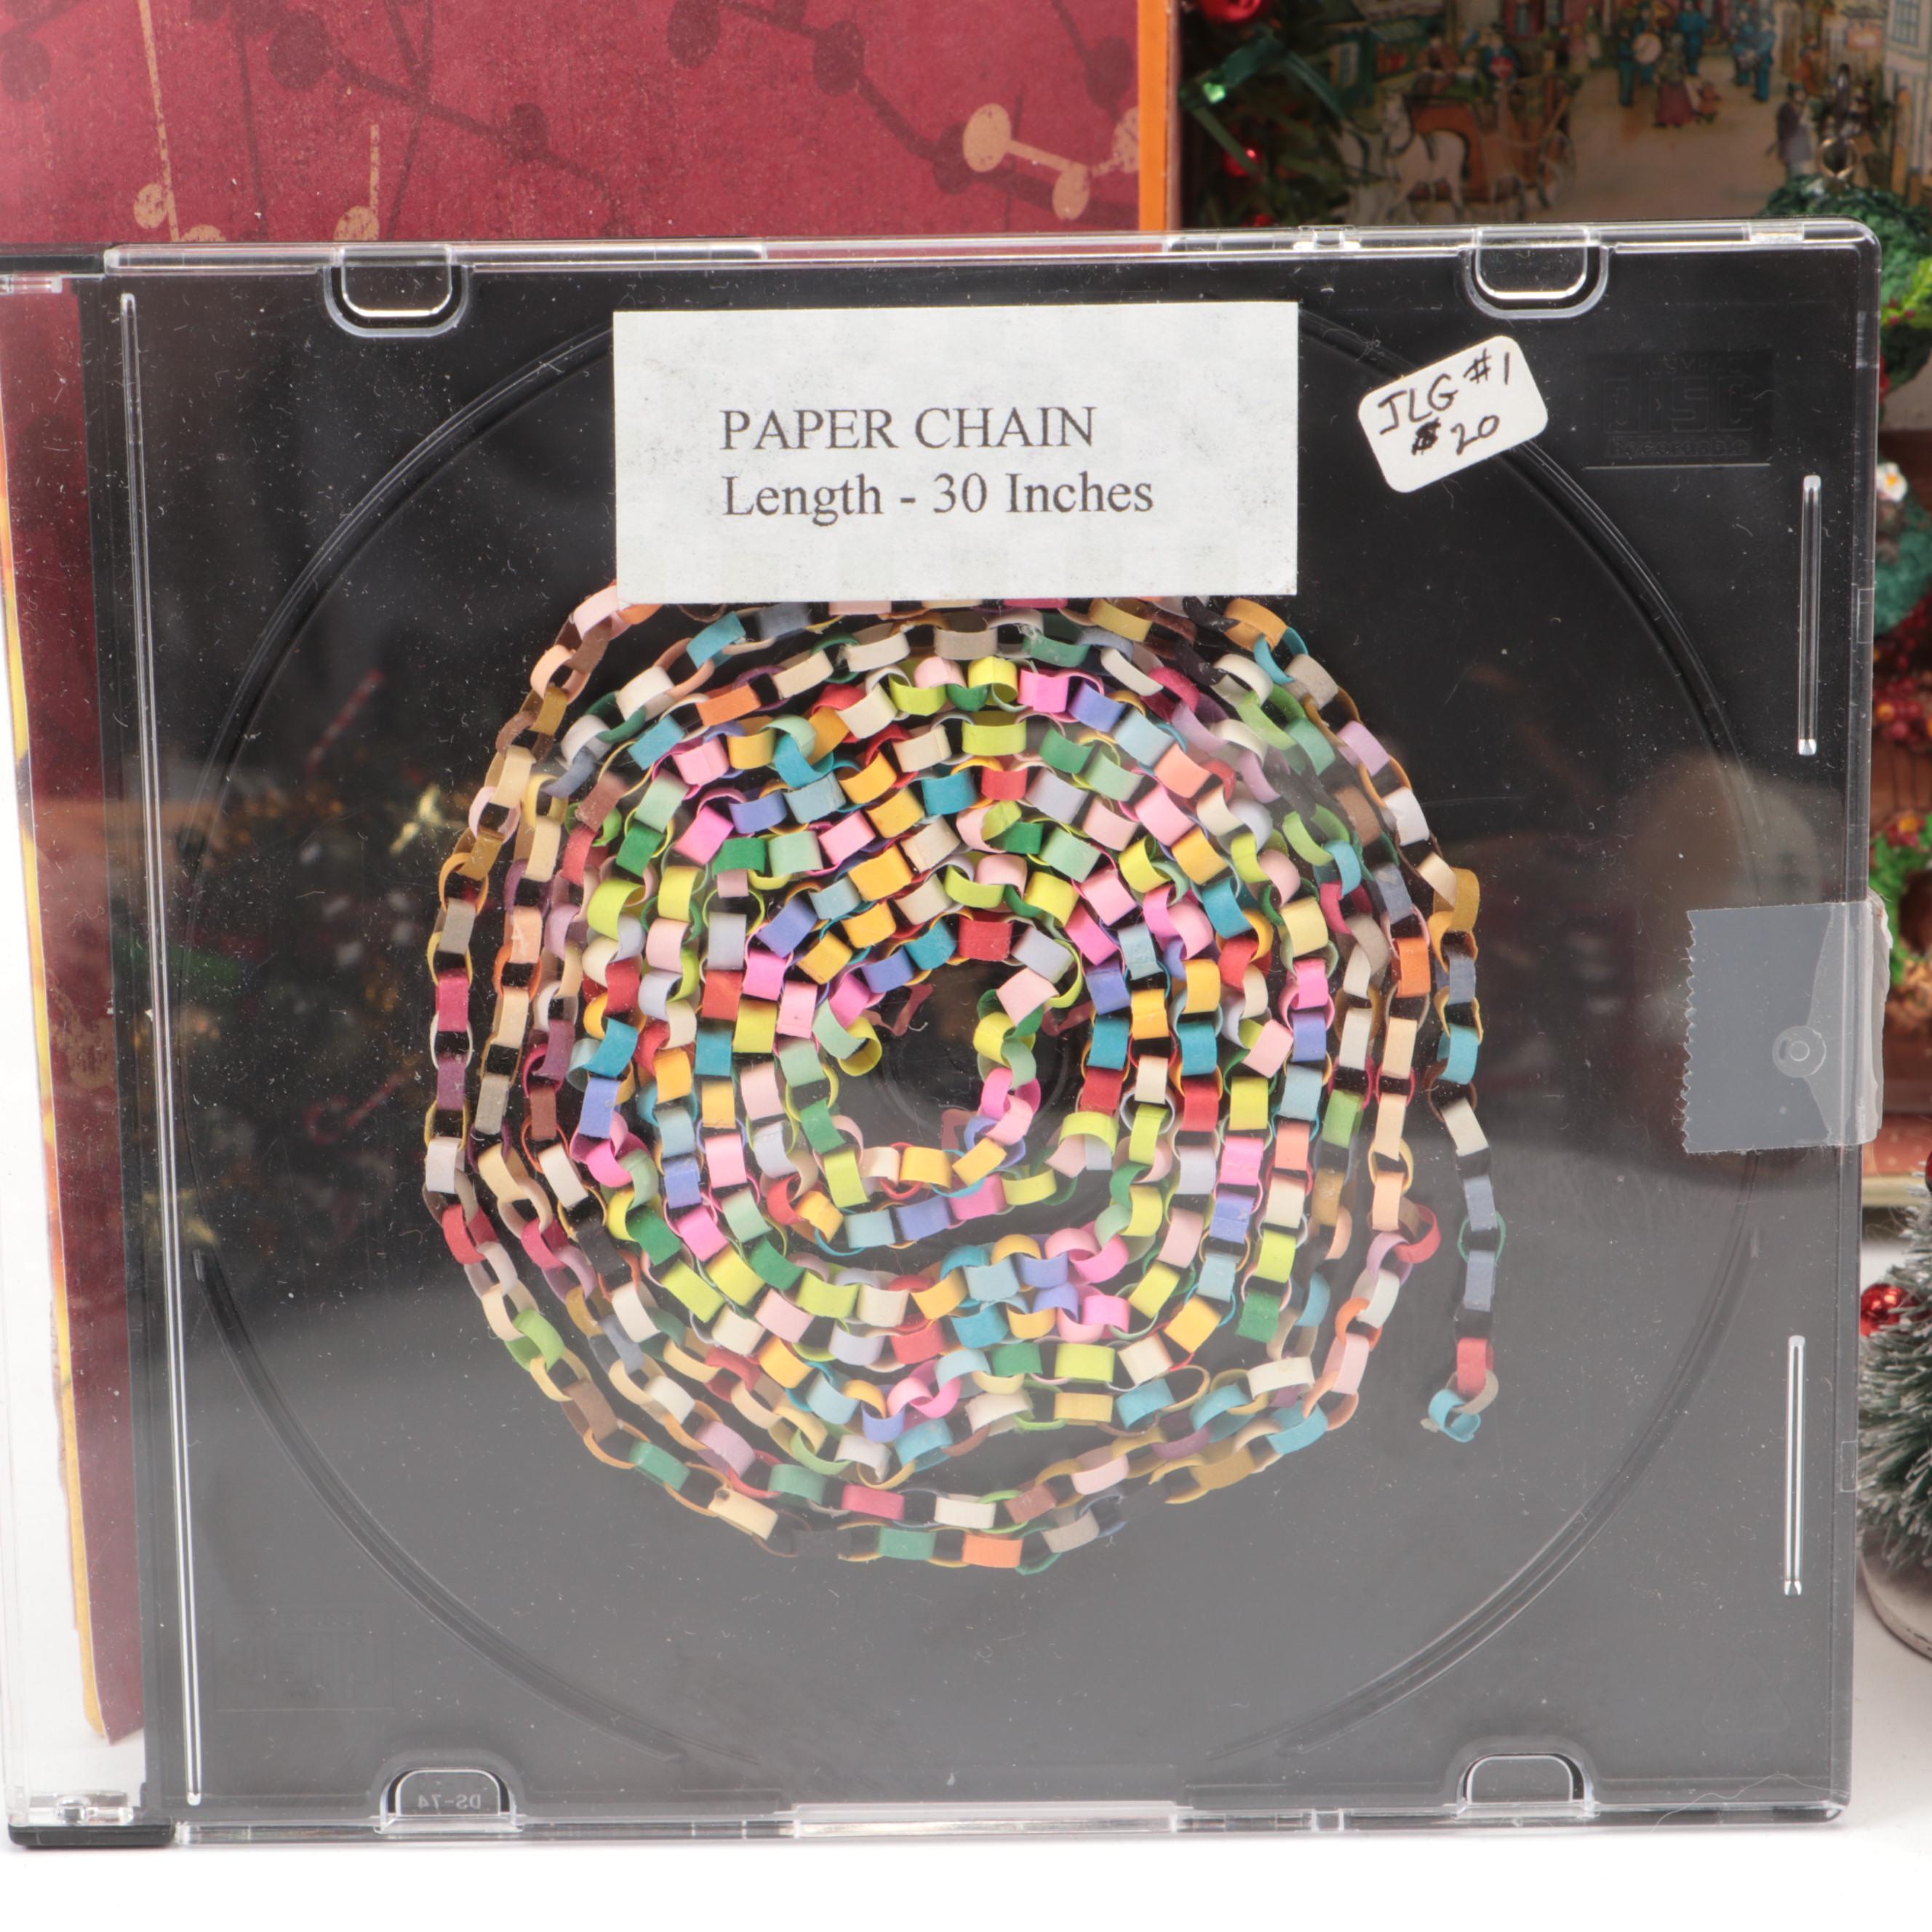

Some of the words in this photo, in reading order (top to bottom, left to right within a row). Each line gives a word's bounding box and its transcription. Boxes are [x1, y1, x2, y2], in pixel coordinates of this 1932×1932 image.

[1378, 373, 1458, 435] JLG
[1463, 348, 1510, 385] #1
[719, 410, 898, 450] PAPER
[915, 407, 1096, 448] CHAIN
[722, 474, 883, 527] Length
[933, 473, 987, 514] 30
[1005, 471, 1154, 514] Inches
